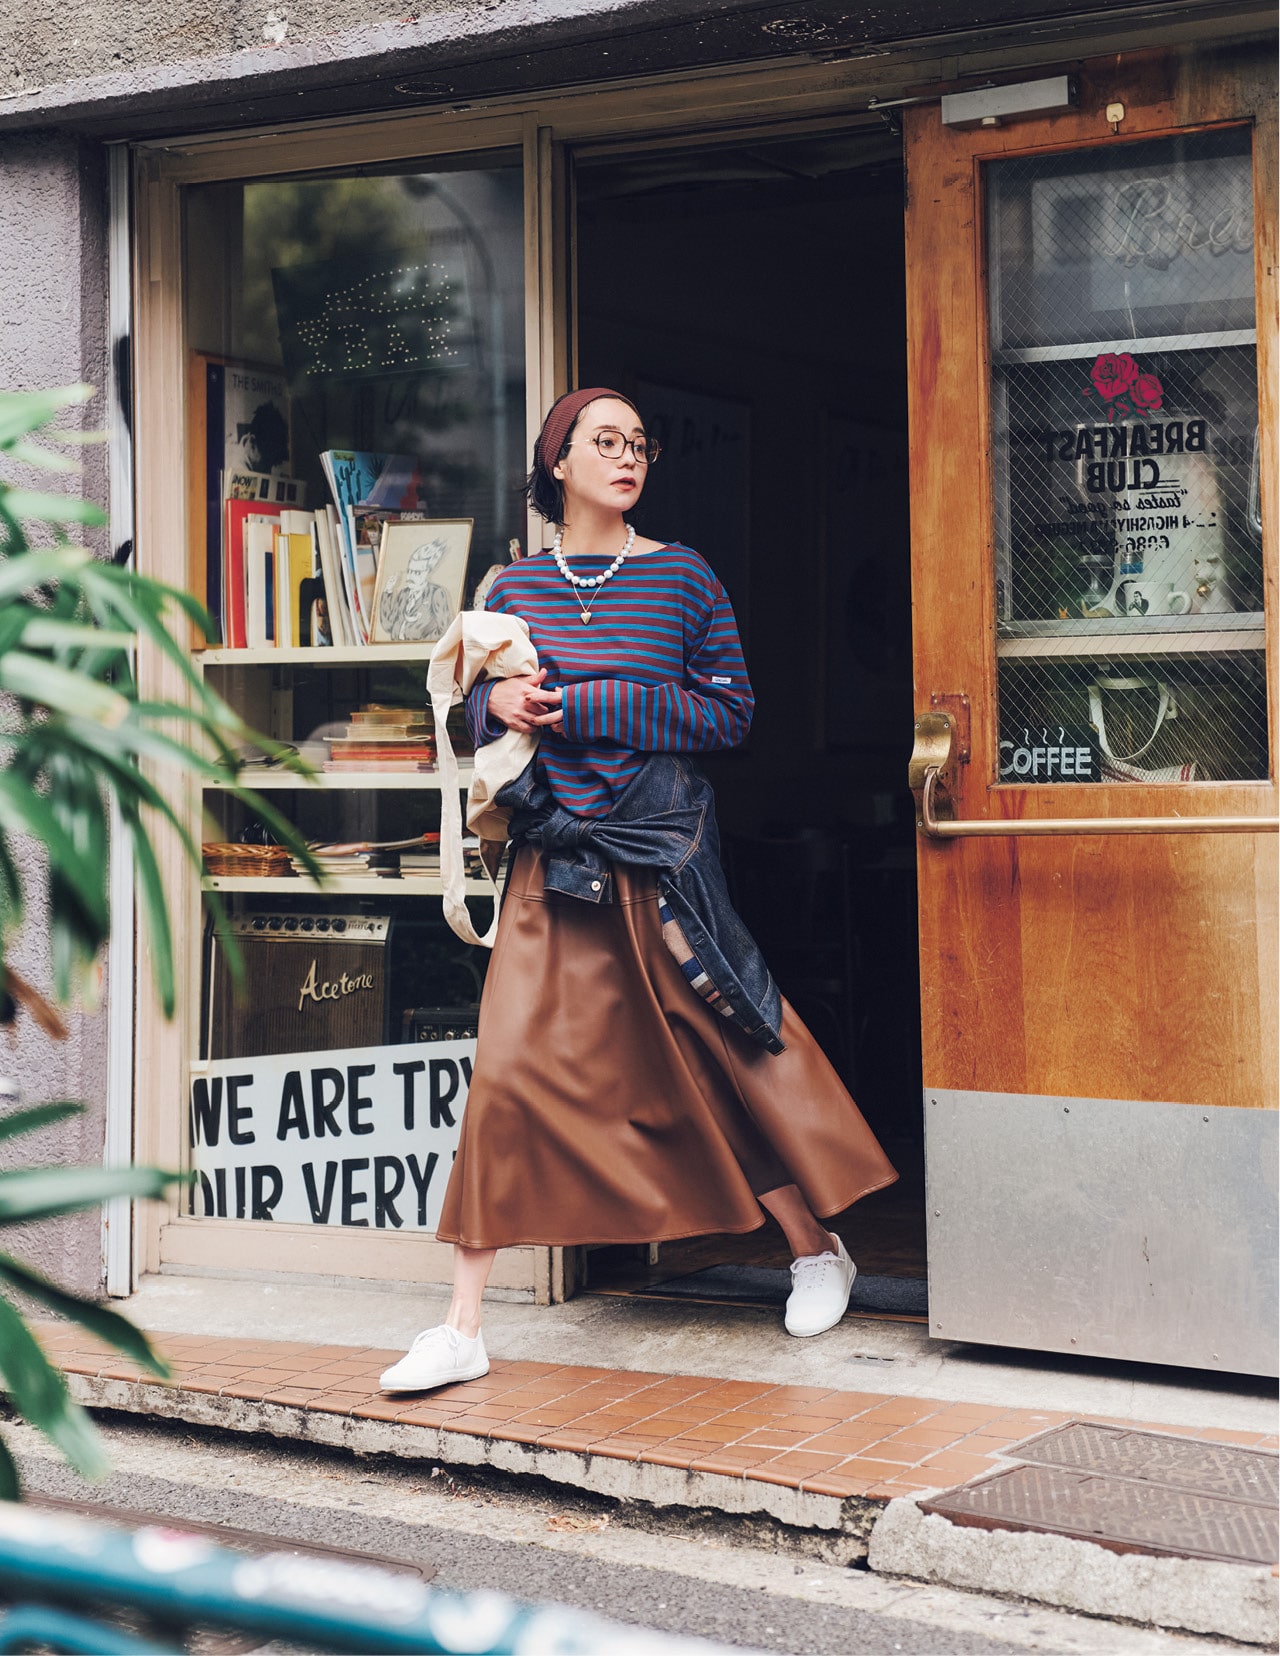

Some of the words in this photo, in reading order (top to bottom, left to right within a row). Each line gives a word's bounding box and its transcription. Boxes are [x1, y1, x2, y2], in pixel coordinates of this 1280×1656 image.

[232, 373, 249, 391] THE
[1000, 741, 1092, 776] COFFEE
[190, 1074, 255, 1148] WE
[277, 1064, 375, 1140] ARE
[188, 1165, 283, 1221] OUR
[301, 1152, 439, 1228] VERY
